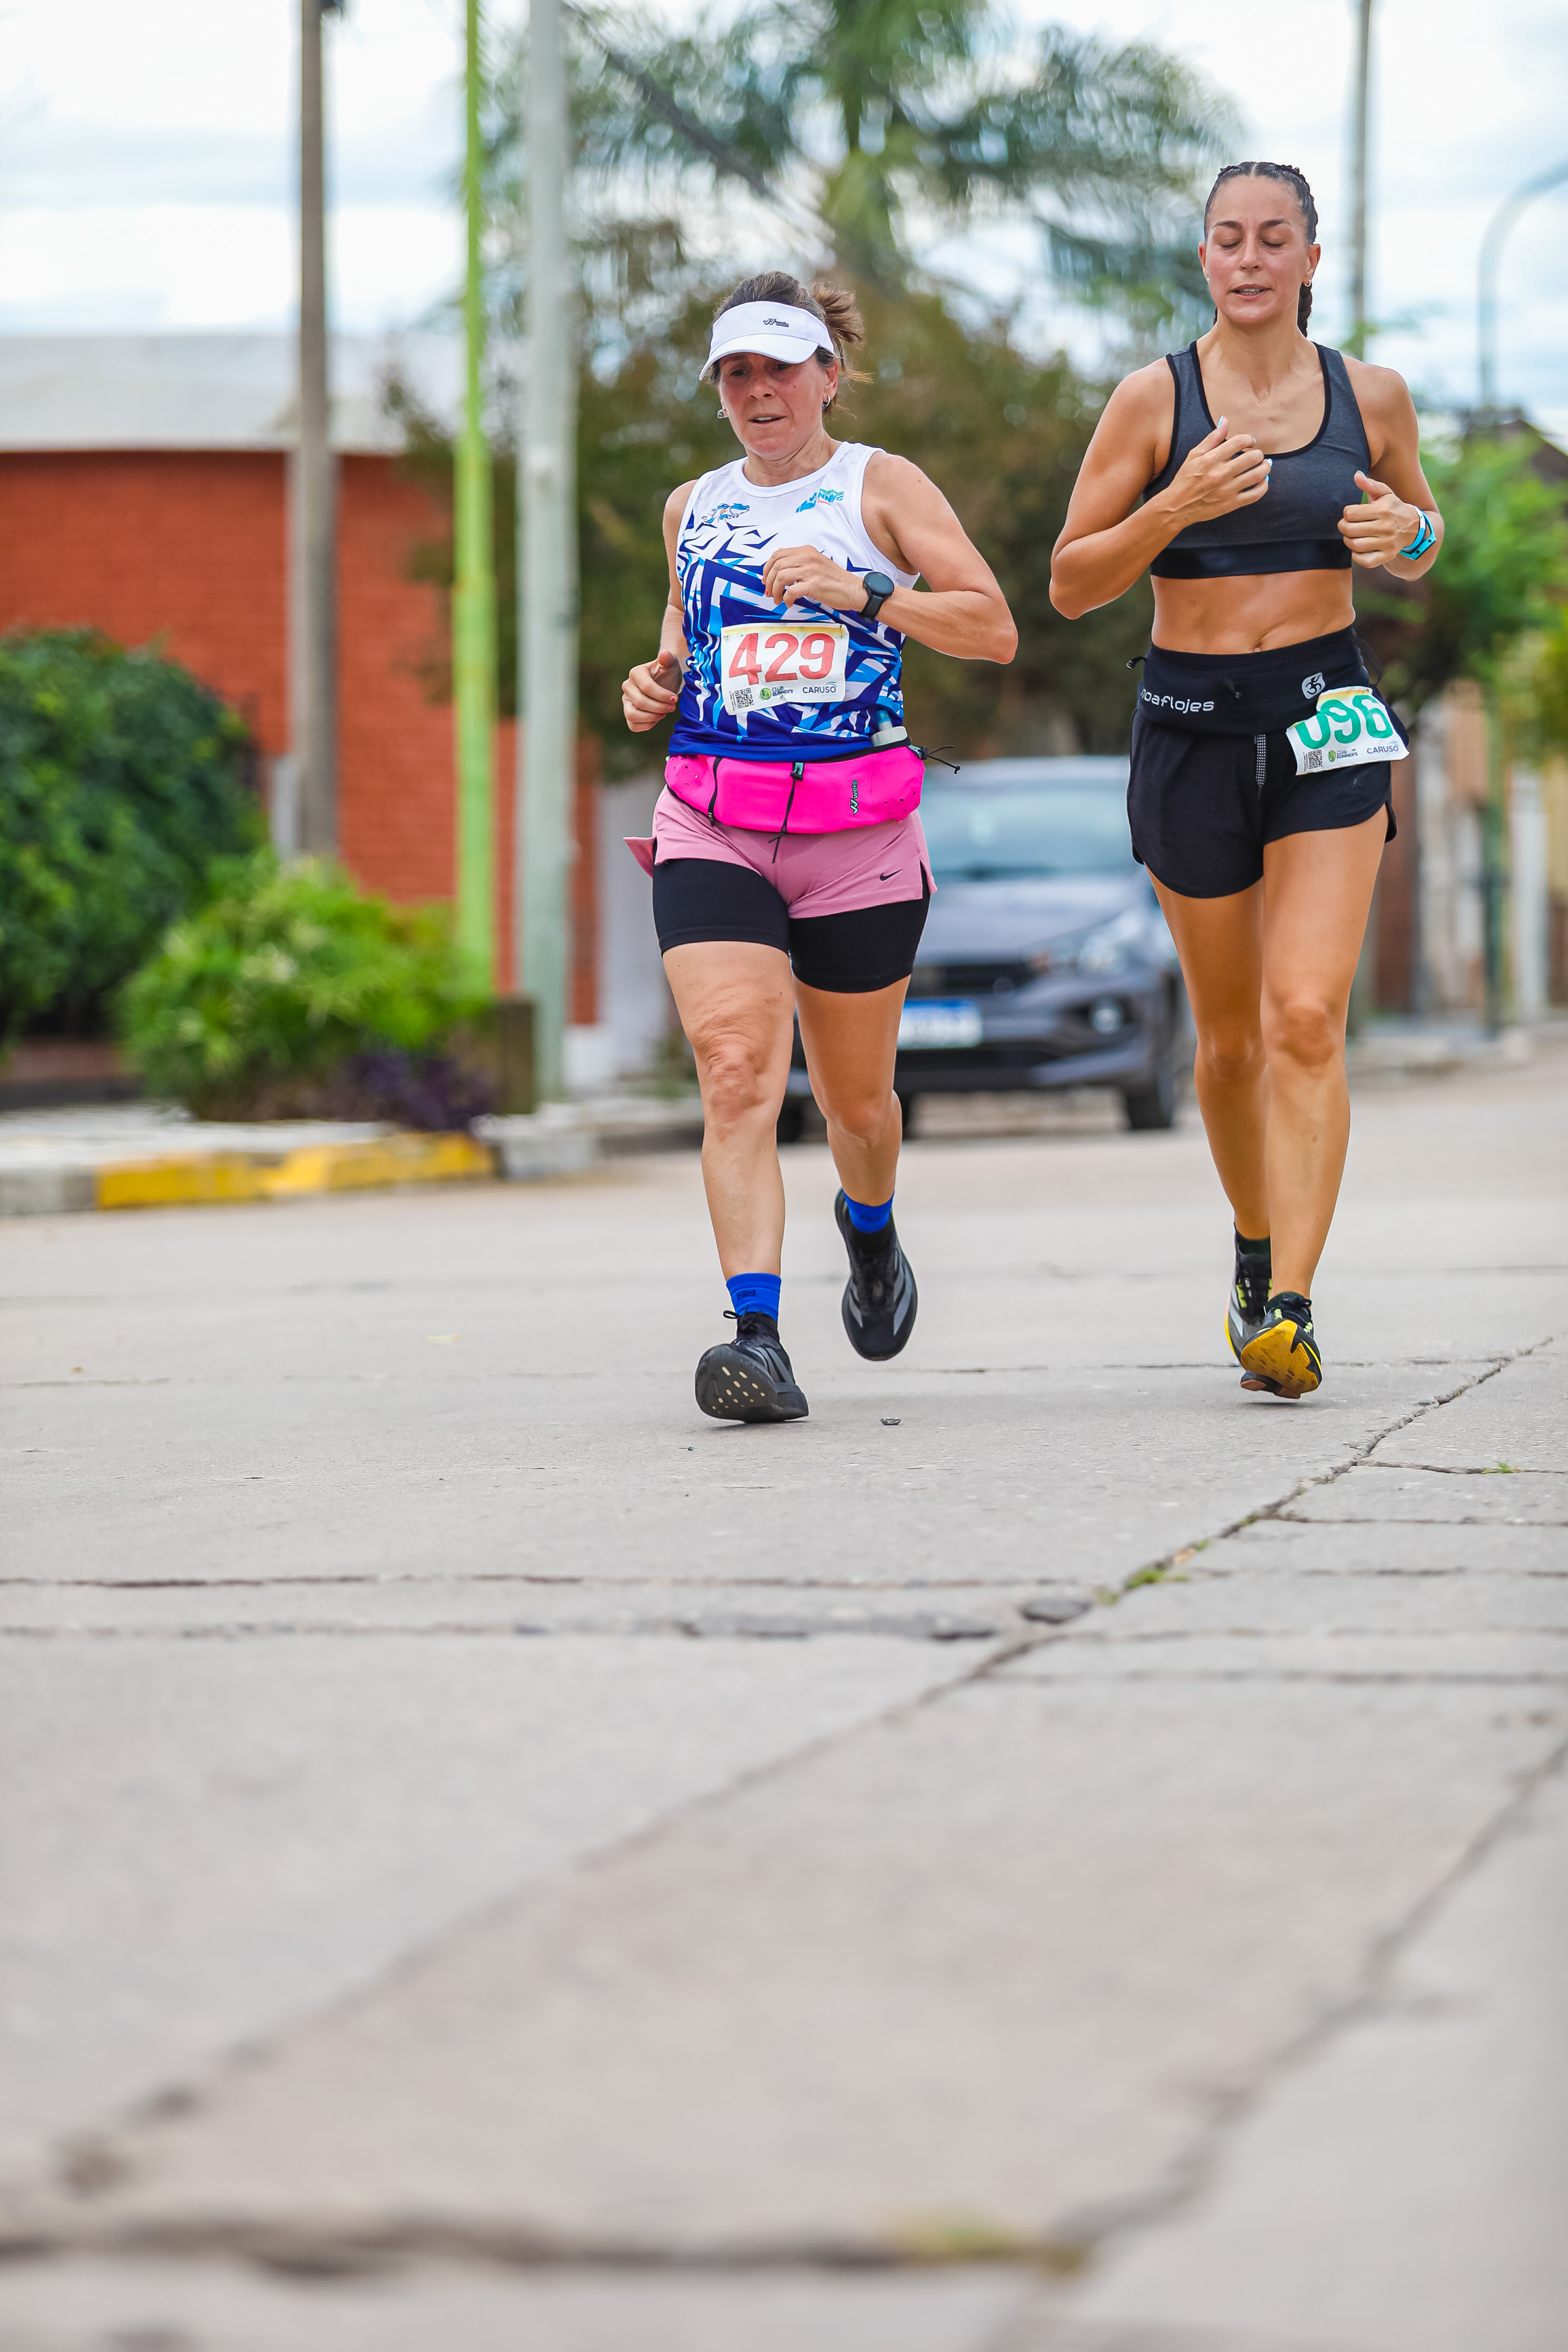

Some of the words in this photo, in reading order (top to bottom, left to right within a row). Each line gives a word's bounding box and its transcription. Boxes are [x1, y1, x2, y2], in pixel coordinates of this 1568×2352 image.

[729, 633, 835, 685] 429
[1295, 695, 1393, 749] 096
[1366, 746, 1399, 754] CARUSO
